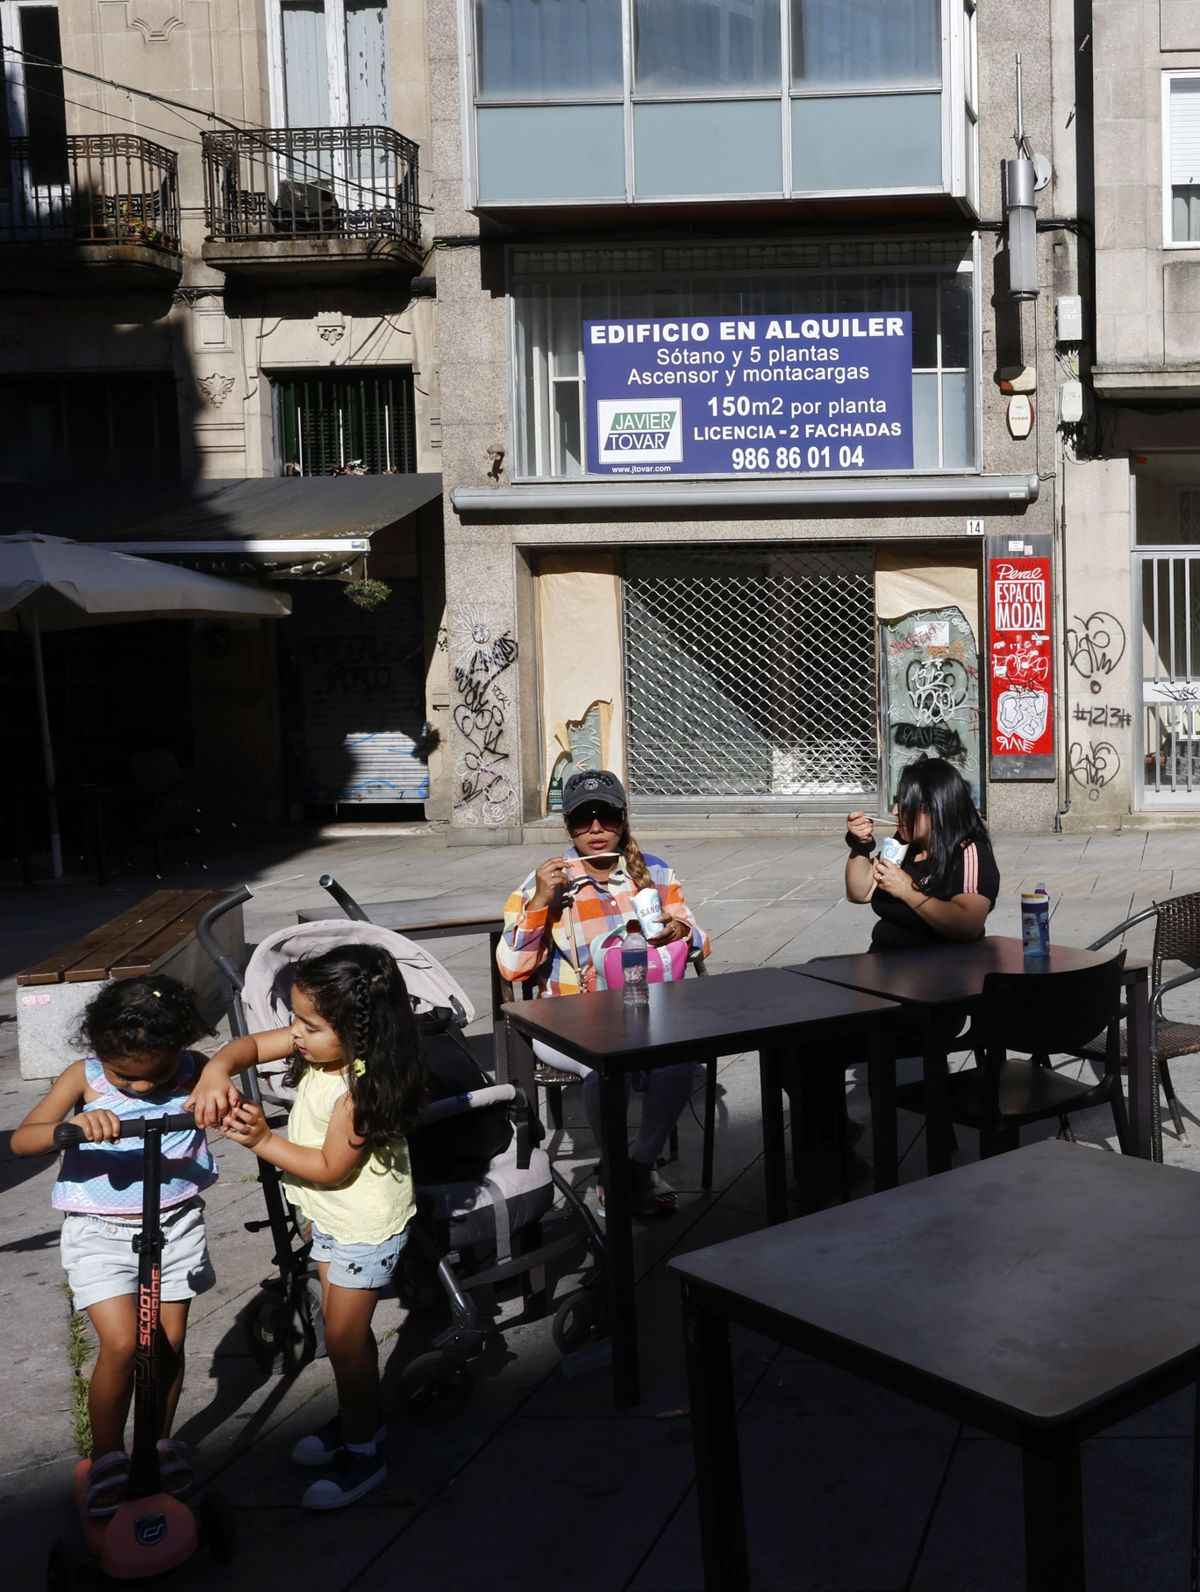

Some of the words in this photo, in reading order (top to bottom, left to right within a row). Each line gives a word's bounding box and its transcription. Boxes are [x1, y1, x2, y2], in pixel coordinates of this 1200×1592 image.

[590, 322, 710, 344] EDIFICIO
[719, 321, 756, 341] EN
[765, 317, 904, 342] ALQUILER
[656, 347, 725, 366] Sótano
[732, 351, 742, 367] y
[750, 346, 761, 363] 5
[769, 345, 840, 366] plantas
[627, 367, 719, 386] Ascensor
[725, 369, 736, 386] y
[743, 363, 870, 384] montacargas
[707, 395, 784, 417] 150m2
[791, 400, 822, 418] por
[829, 395, 887, 417] planta
[615, 413, 671, 430] JAVIER
[693, 425, 776, 441] LICENCIA
[790, 424, 799, 440] 2
[805, 422, 902, 438] FACHADAS
[609, 433, 665, 450] TOVAR
[732, 447, 770, 470] 986
[776, 447, 801, 470] 86
[807, 446, 831, 469] 01
[839, 445, 865, 468] 04
[611, 465, 672, 474] www.jtovar.com
[969, 521, 981, 534] 14
[997, 583, 1042, 603] ESPACIO
[997, 603, 1043, 629] MODA
[140, 1283, 151, 1346] SCOOT
